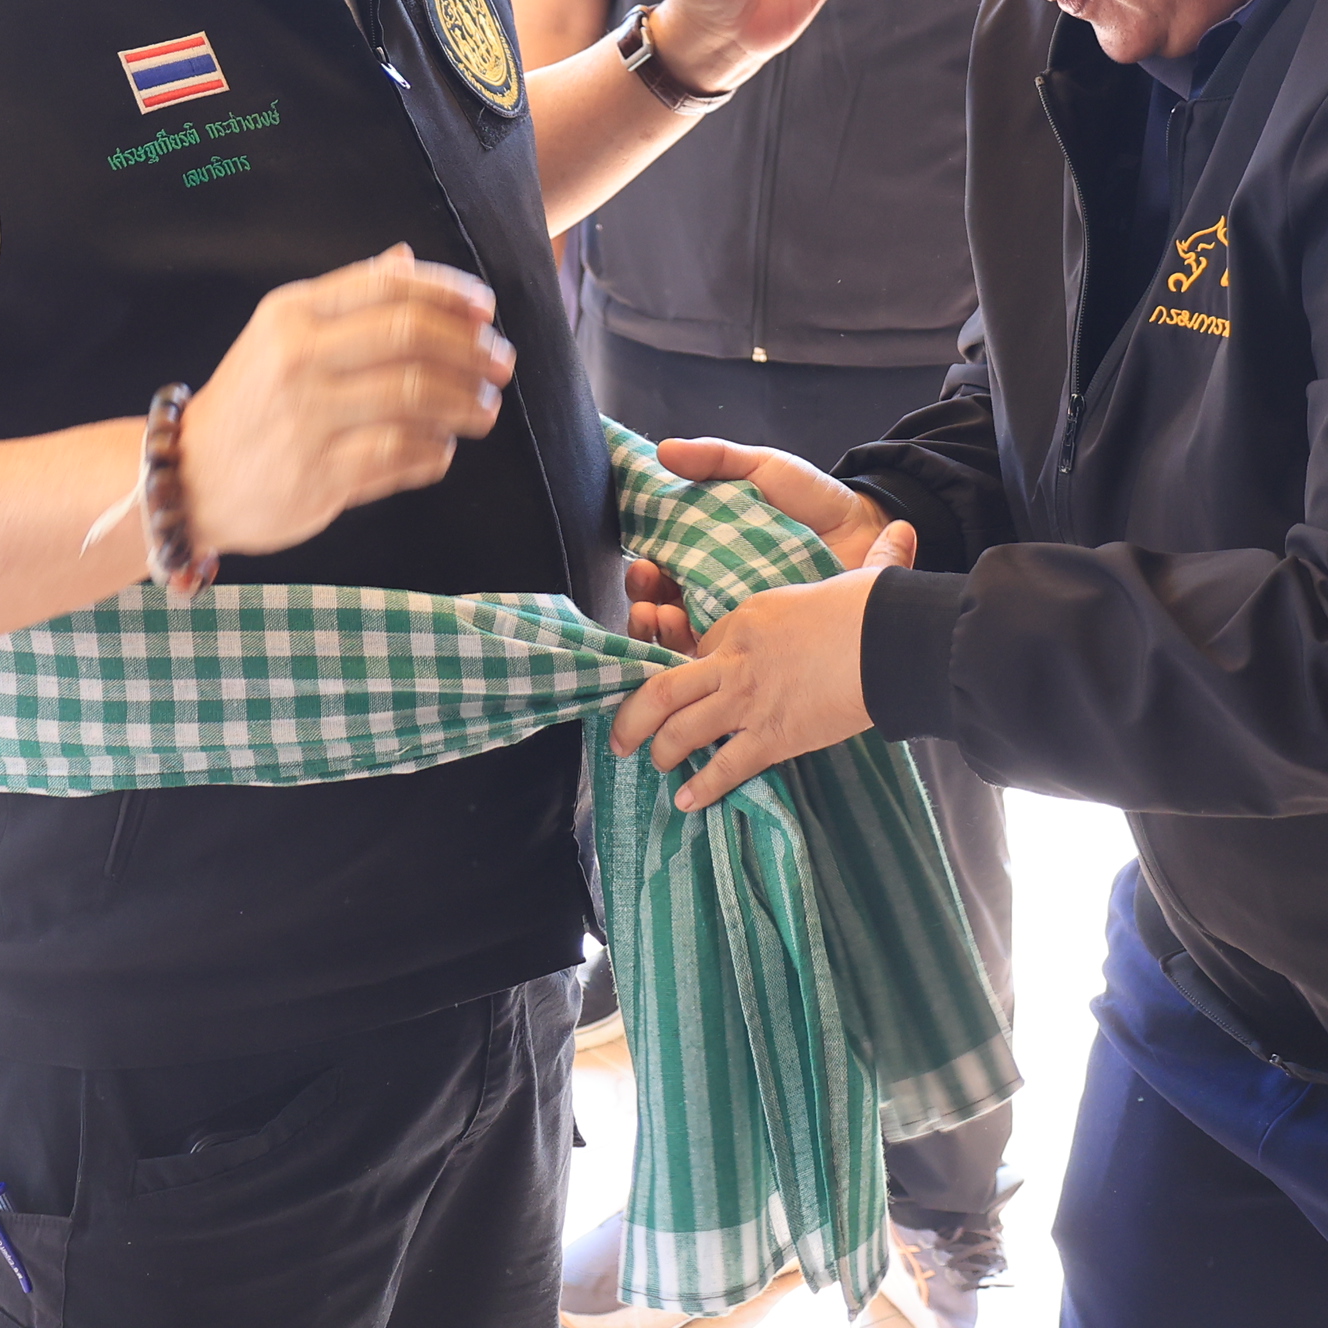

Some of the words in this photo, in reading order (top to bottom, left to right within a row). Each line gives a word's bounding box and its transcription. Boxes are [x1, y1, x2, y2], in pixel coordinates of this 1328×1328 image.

[107, 122, 201, 171] เศรษฐเกียรติ
[205, 100, 280, 139] กระจ่างวงษ์
[182, 154, 251, 188] เลขาธิการ
